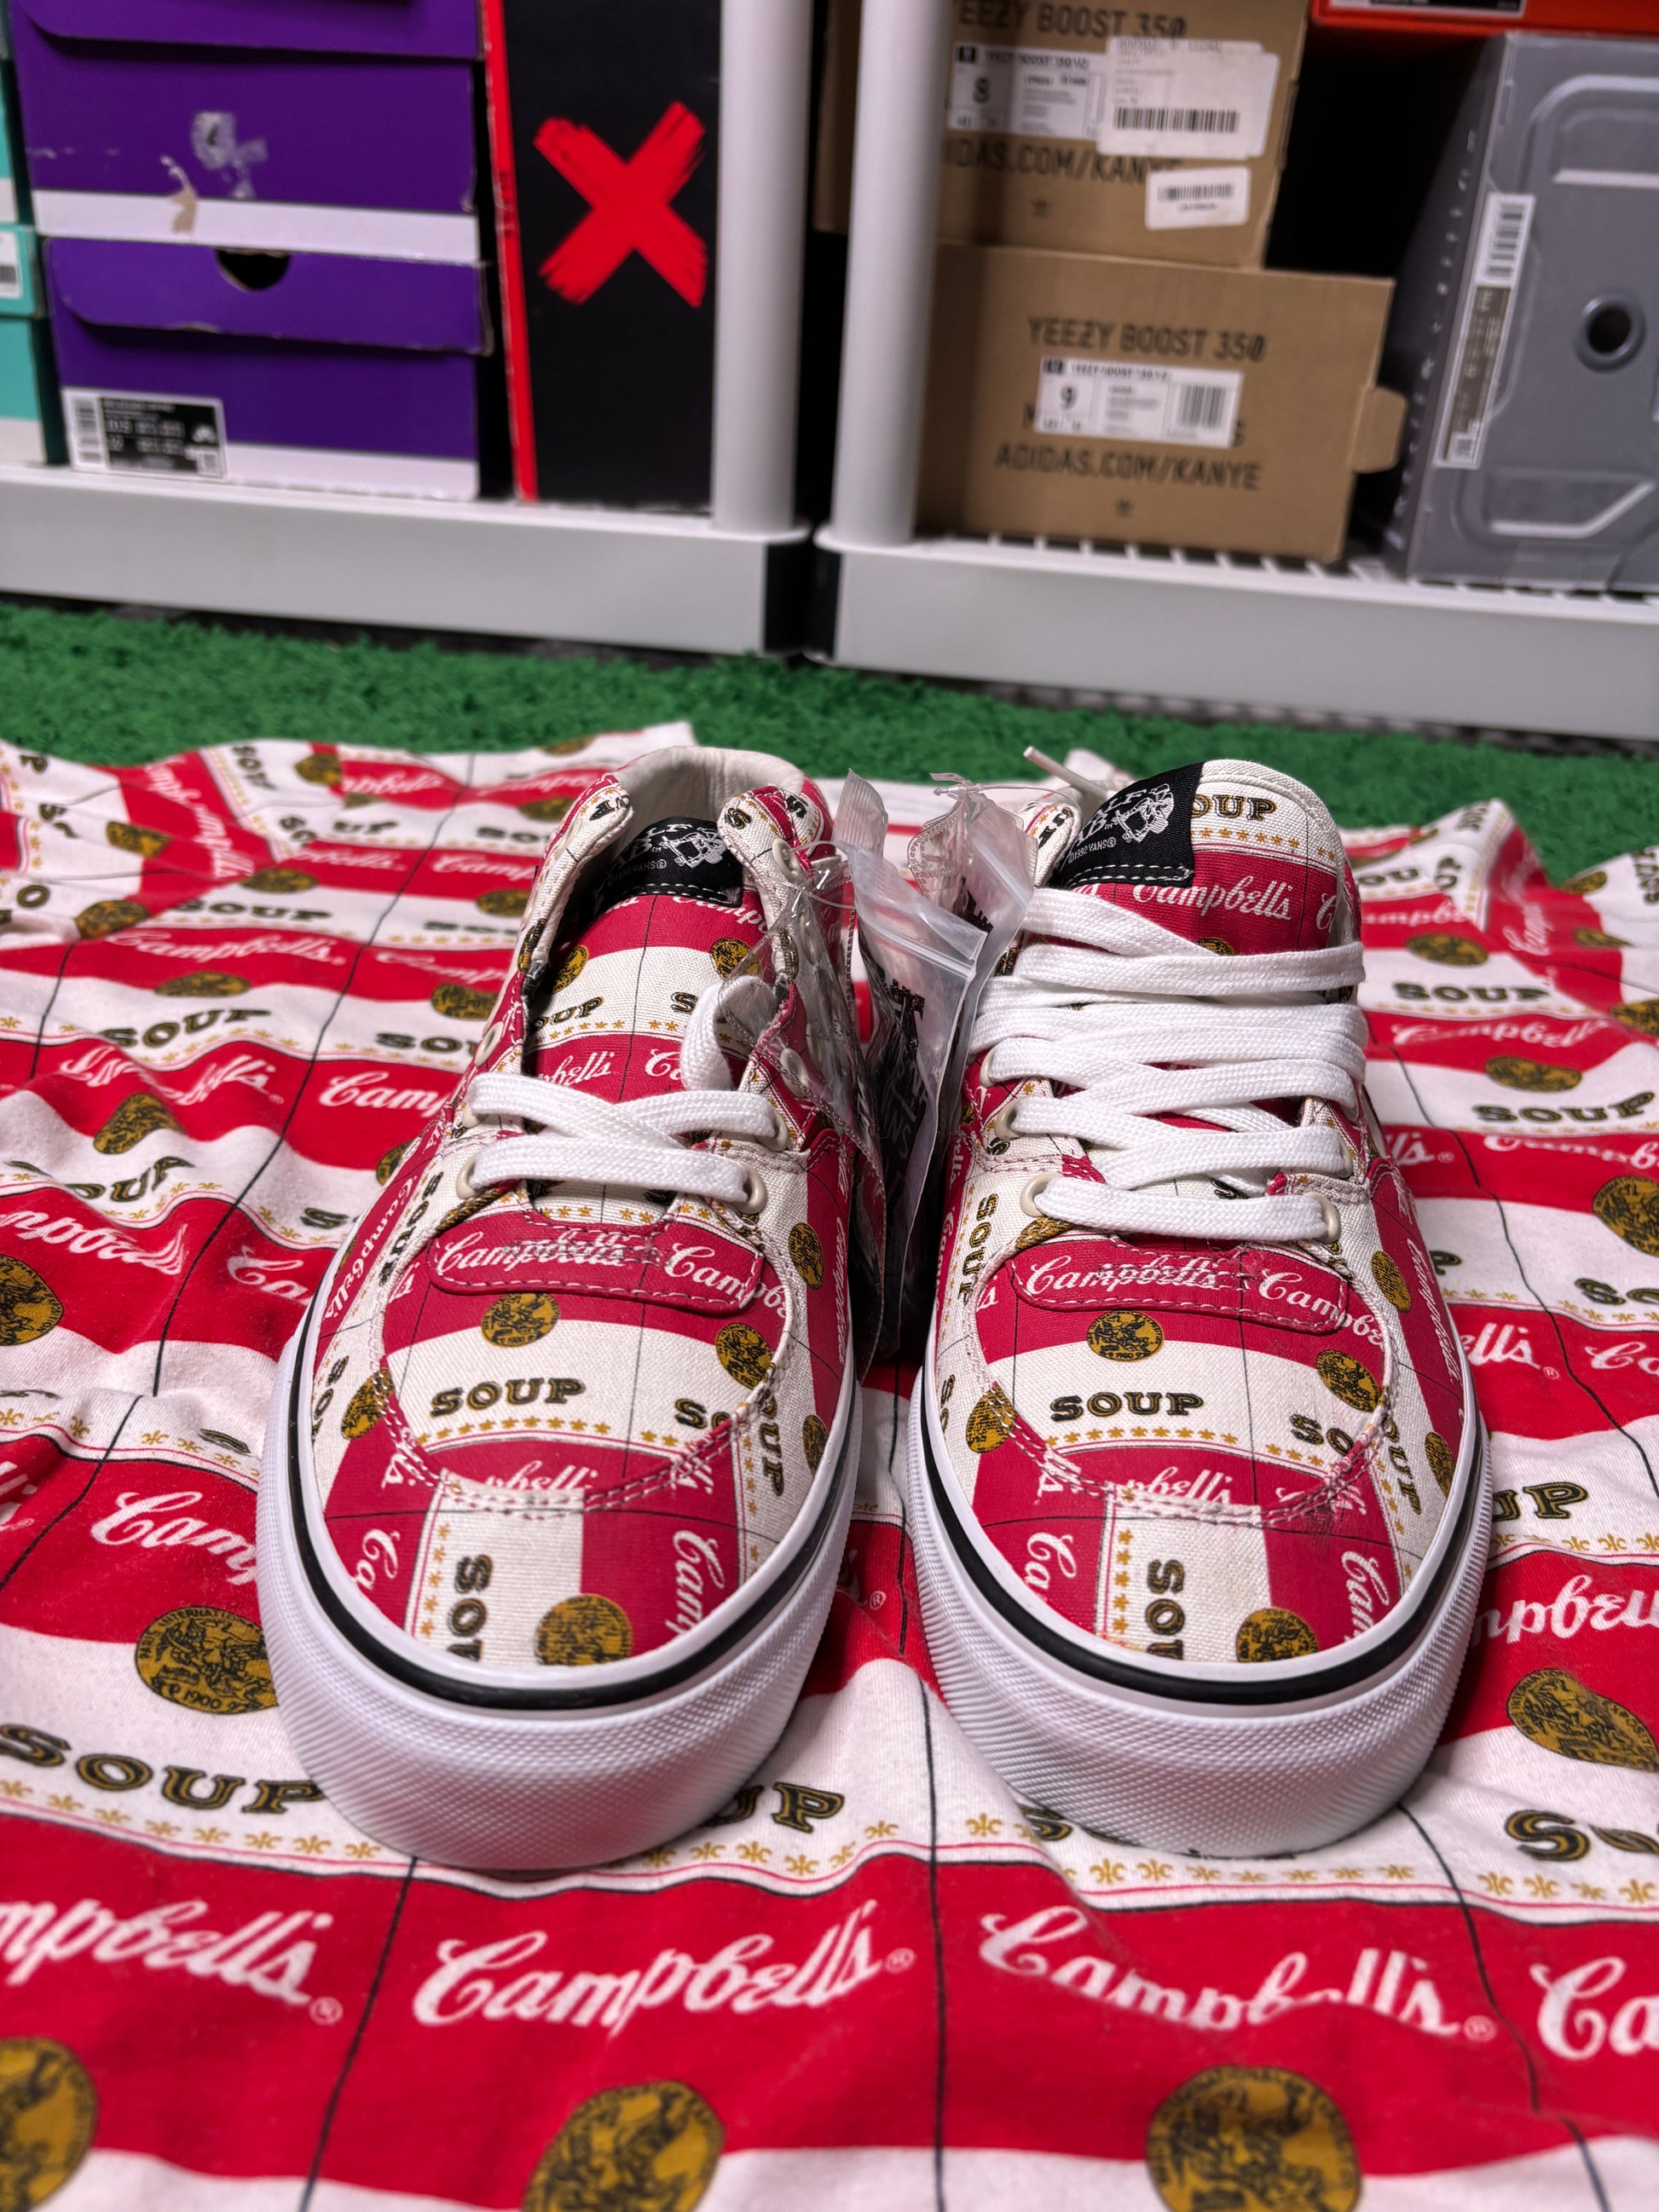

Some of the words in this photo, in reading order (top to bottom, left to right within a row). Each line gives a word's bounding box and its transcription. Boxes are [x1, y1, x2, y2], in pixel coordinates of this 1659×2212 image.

[1037, 3, 1124, 38] BOOST
[1026, 316, 1115, 350] YEEZY
[1119, 324, 1209, 358] BOOST
[1213, 330, 1268, 363] 350
[994, 442, 1262, 491] ADIDAS.COM/KANYE
[1391, 981, 1552, 1003] SOUP
[97, 1008, 273, 1048] SOUP
[1471, 1090, 1656, 1123] SOUP
[429, 1377, 587, 1418] SOUP
[1049, 1391, 1205, 1423] SOUP
[0, 1723, 329, 1814] SOUP
[412, 1899, 882, 2042] Campbell's
